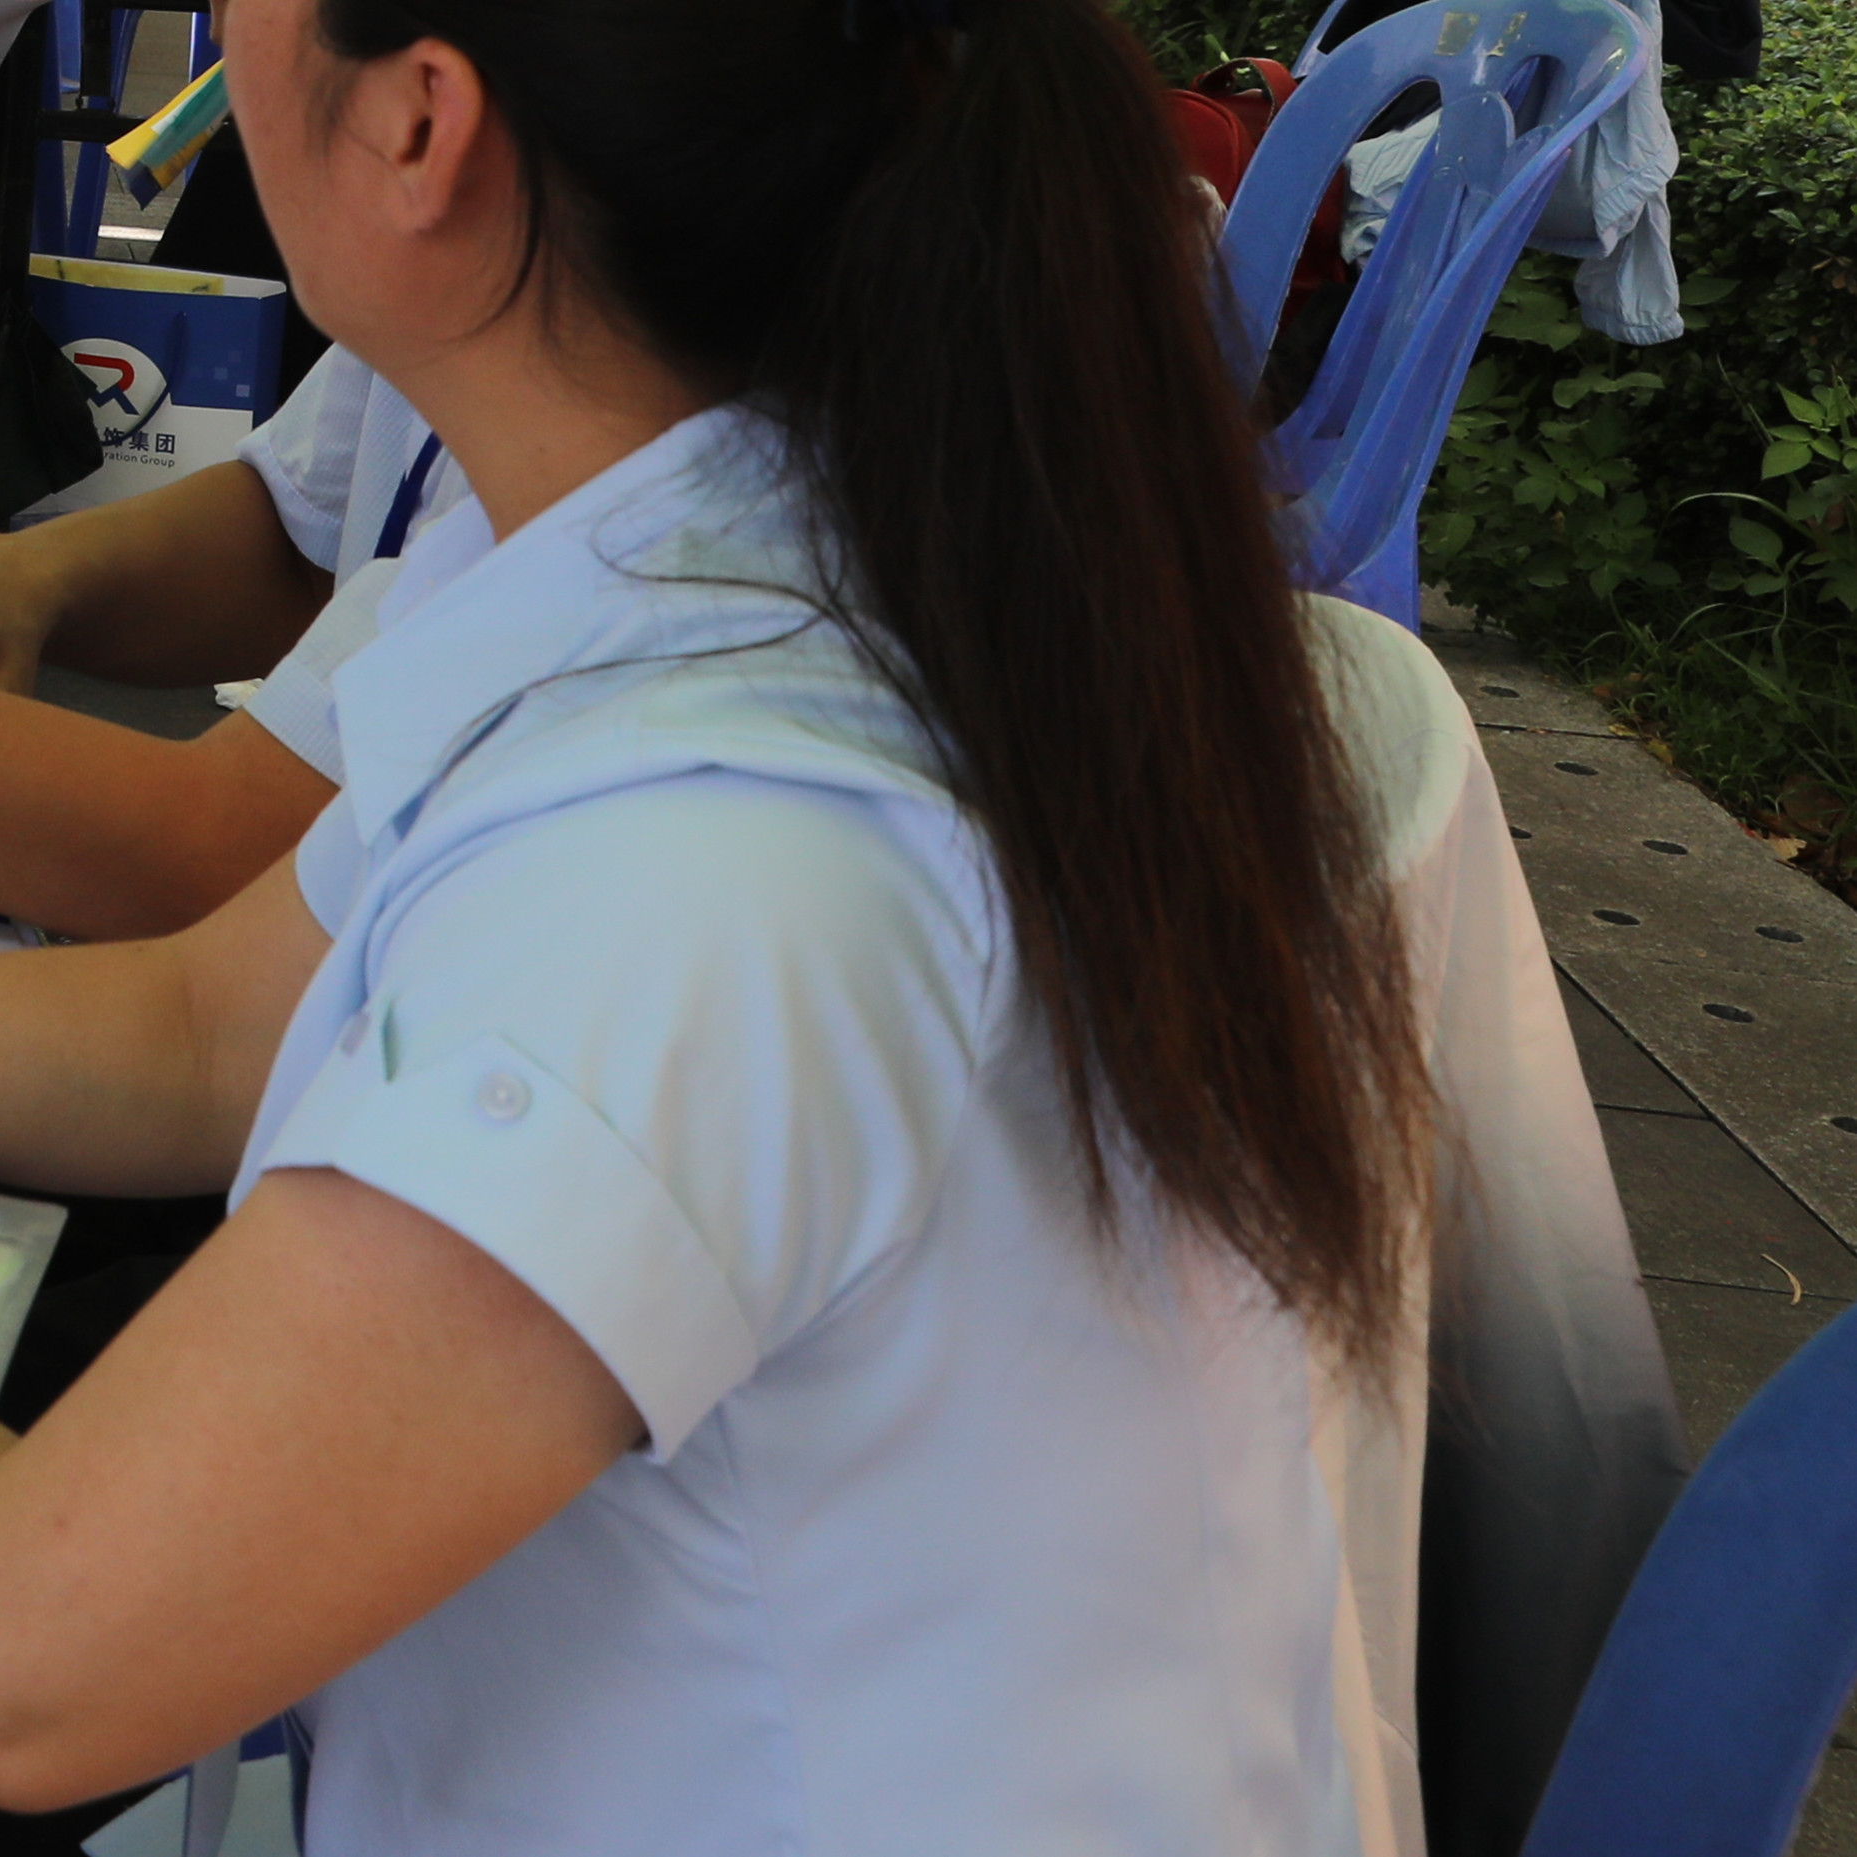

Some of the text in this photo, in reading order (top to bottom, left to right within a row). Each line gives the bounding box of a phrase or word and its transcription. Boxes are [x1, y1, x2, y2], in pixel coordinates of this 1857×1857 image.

[100, 427, 175, 454] 饰集团
[104, 451, 175, 468] ration Group
